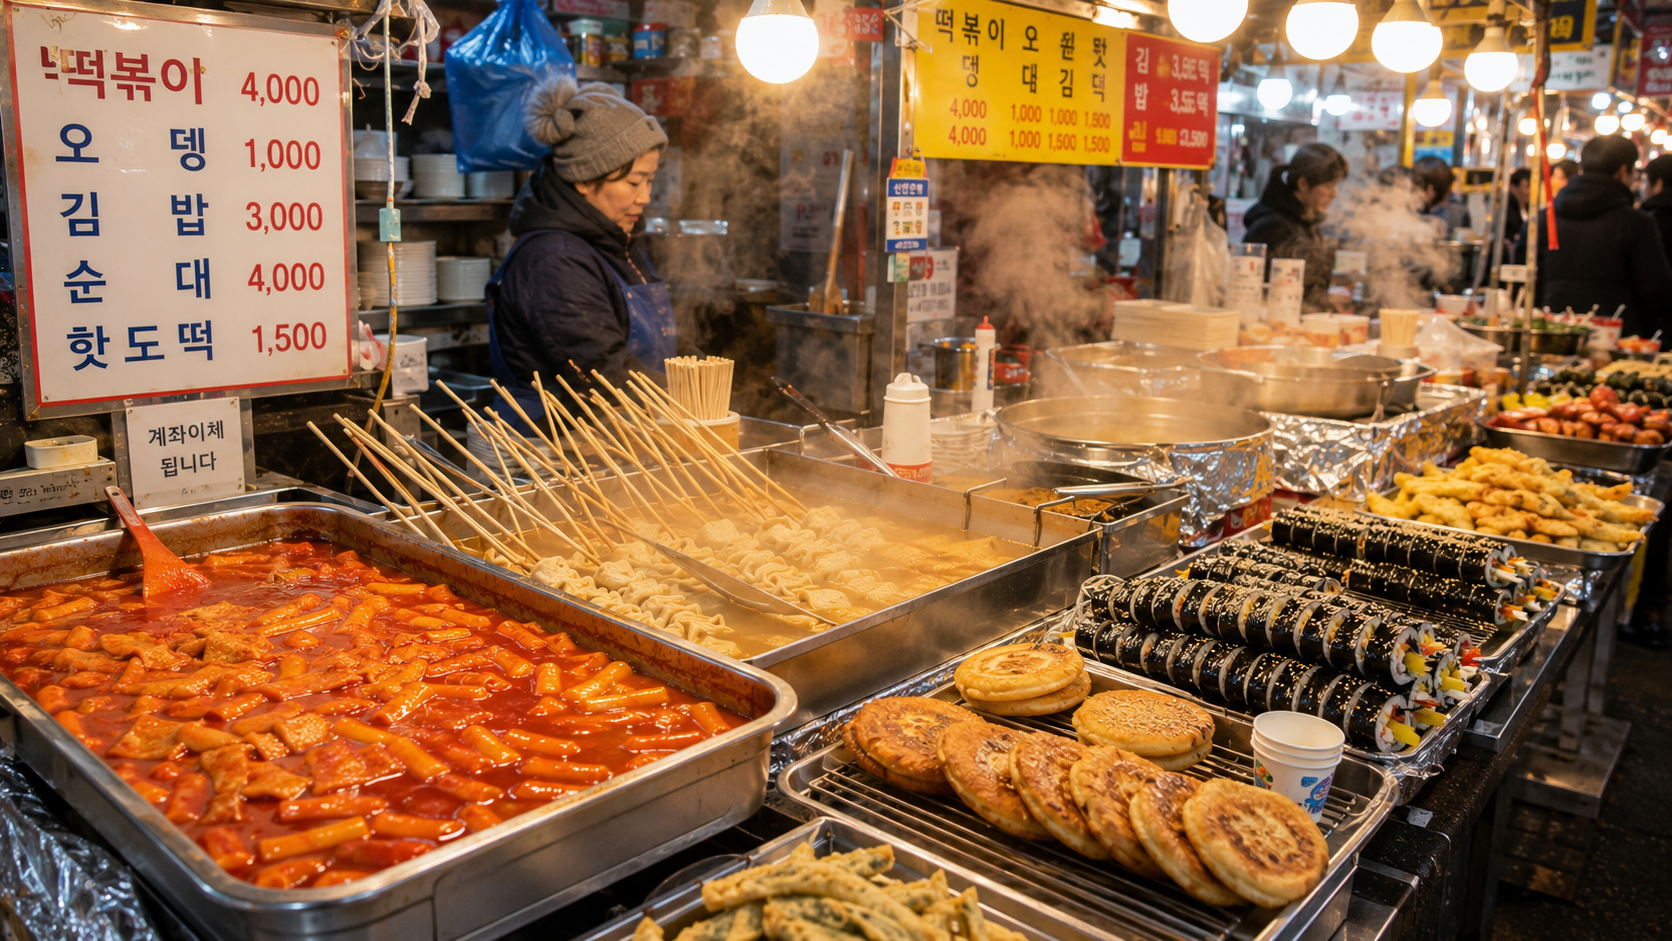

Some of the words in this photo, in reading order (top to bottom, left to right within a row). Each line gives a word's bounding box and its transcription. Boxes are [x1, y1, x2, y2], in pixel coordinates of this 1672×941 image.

[241, 71, 320, 106] 4,000
[1059, 68, 1074, 99] 김
[949, 98, 988, 120] 4,000
[1011, 103, 1042, 124] 1,000
[948, 125, 987, 147] 4,000
[1009, 130, 1041, 149] 1,000
[244, 138, 321, 172] 1,000
[245, 201, 323, 235] 3,000
[247, 262, 325, 296] 4,000
[251, 321, 327, 356] 1,500
[148, 420, 224, 447] 계좌이체
[160, 451, 217, 478] 됩니다
